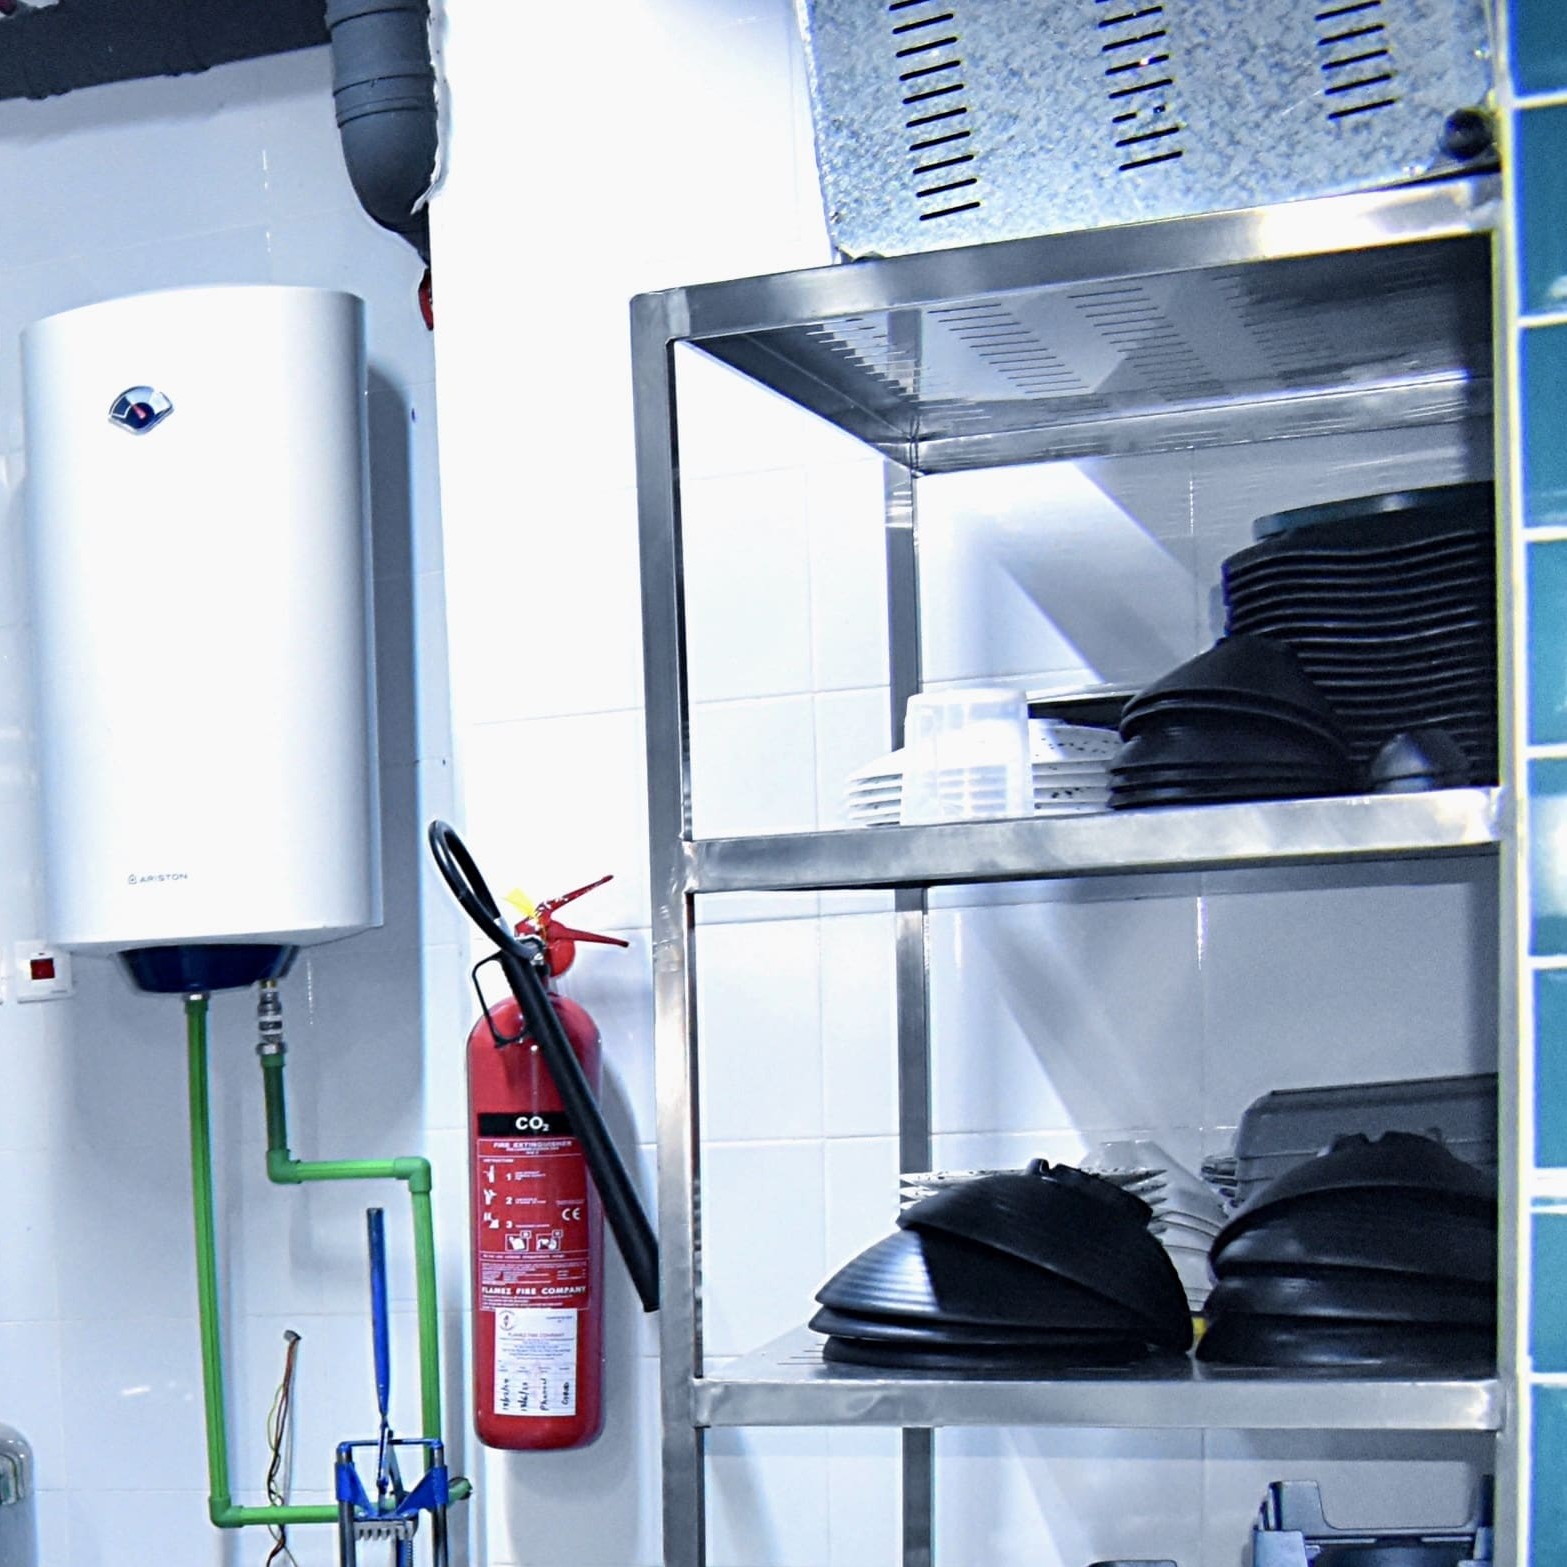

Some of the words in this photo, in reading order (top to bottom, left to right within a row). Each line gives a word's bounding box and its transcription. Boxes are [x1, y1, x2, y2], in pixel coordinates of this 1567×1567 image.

[140, 873, 188, 882] ARISTON
[513, 1140, 572, 1148] EXTINGUISHER
[506, 1173, 512, 1181] 1
[506, 1197, 513, 1205] 2
[506, 1221, 513, 1229] 3
[515, 1287, 537, 1295] FIRE
[541, 1285, 586, 1295] COMPANY
